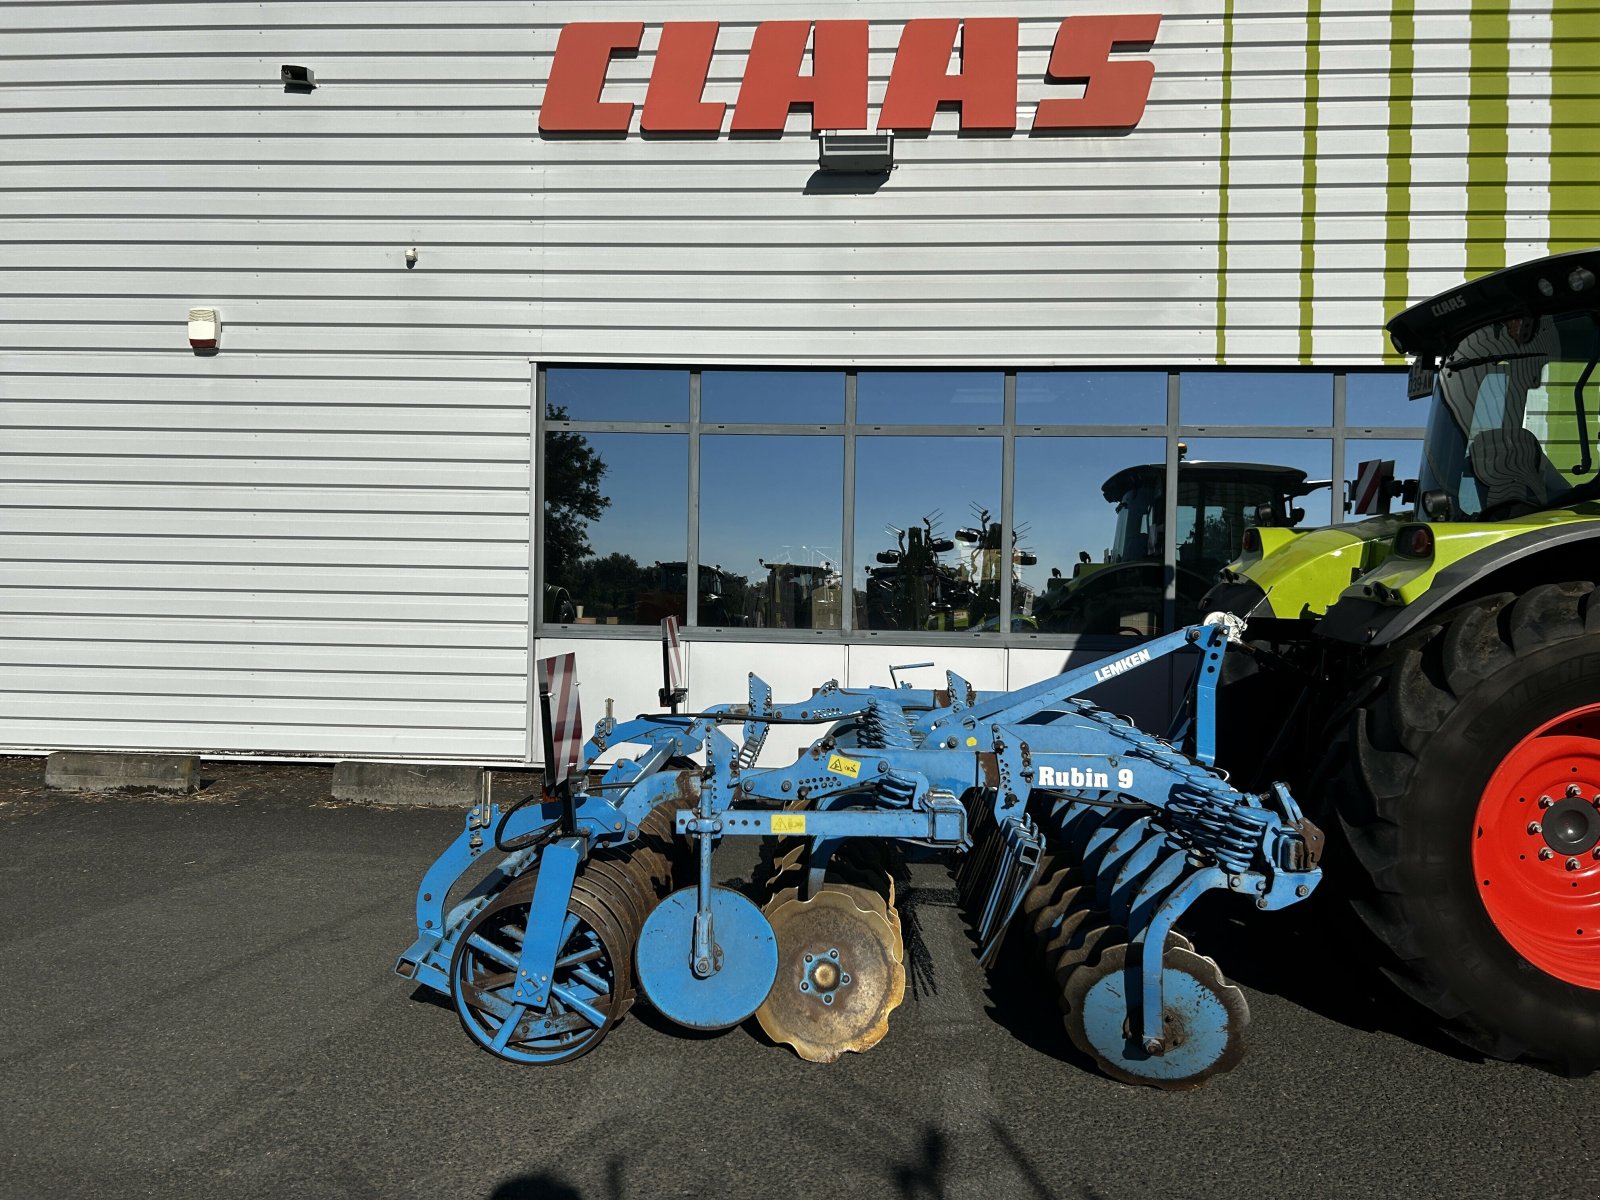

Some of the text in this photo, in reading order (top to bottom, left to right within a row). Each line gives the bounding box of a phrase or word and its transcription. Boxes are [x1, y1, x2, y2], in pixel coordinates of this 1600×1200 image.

[538, 14, 1162, 134] CLAAS
[1431, 294, 1467, 317] CLAAS
[1094, 649, 1151, 682] LEMKEN
[1038, 766, 1134, 788] Rubin 9
